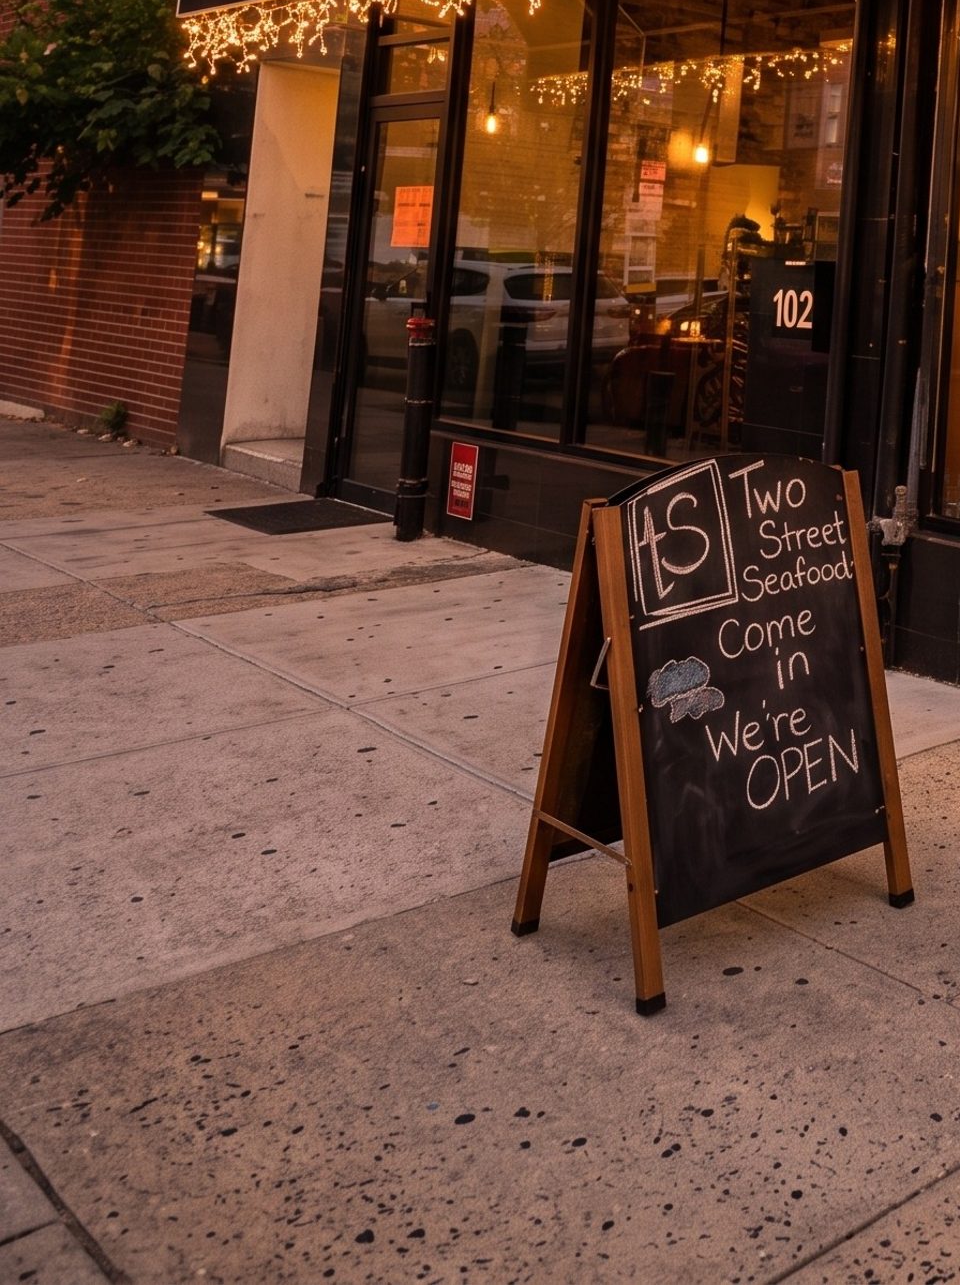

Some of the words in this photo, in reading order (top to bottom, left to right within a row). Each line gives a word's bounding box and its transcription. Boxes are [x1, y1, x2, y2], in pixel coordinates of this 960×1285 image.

[772, 288, 814, 330] 102
[728, 460, 807, 518] Two
[759, 510, 847, 559] Street
[740, 550, 853, 602] Seafood
[718, 610, 816, 659] Come
[774, 647, 810, 690] in
[705, 699, 812, 762] We're
[747, 728, 859, 810] OPEN
